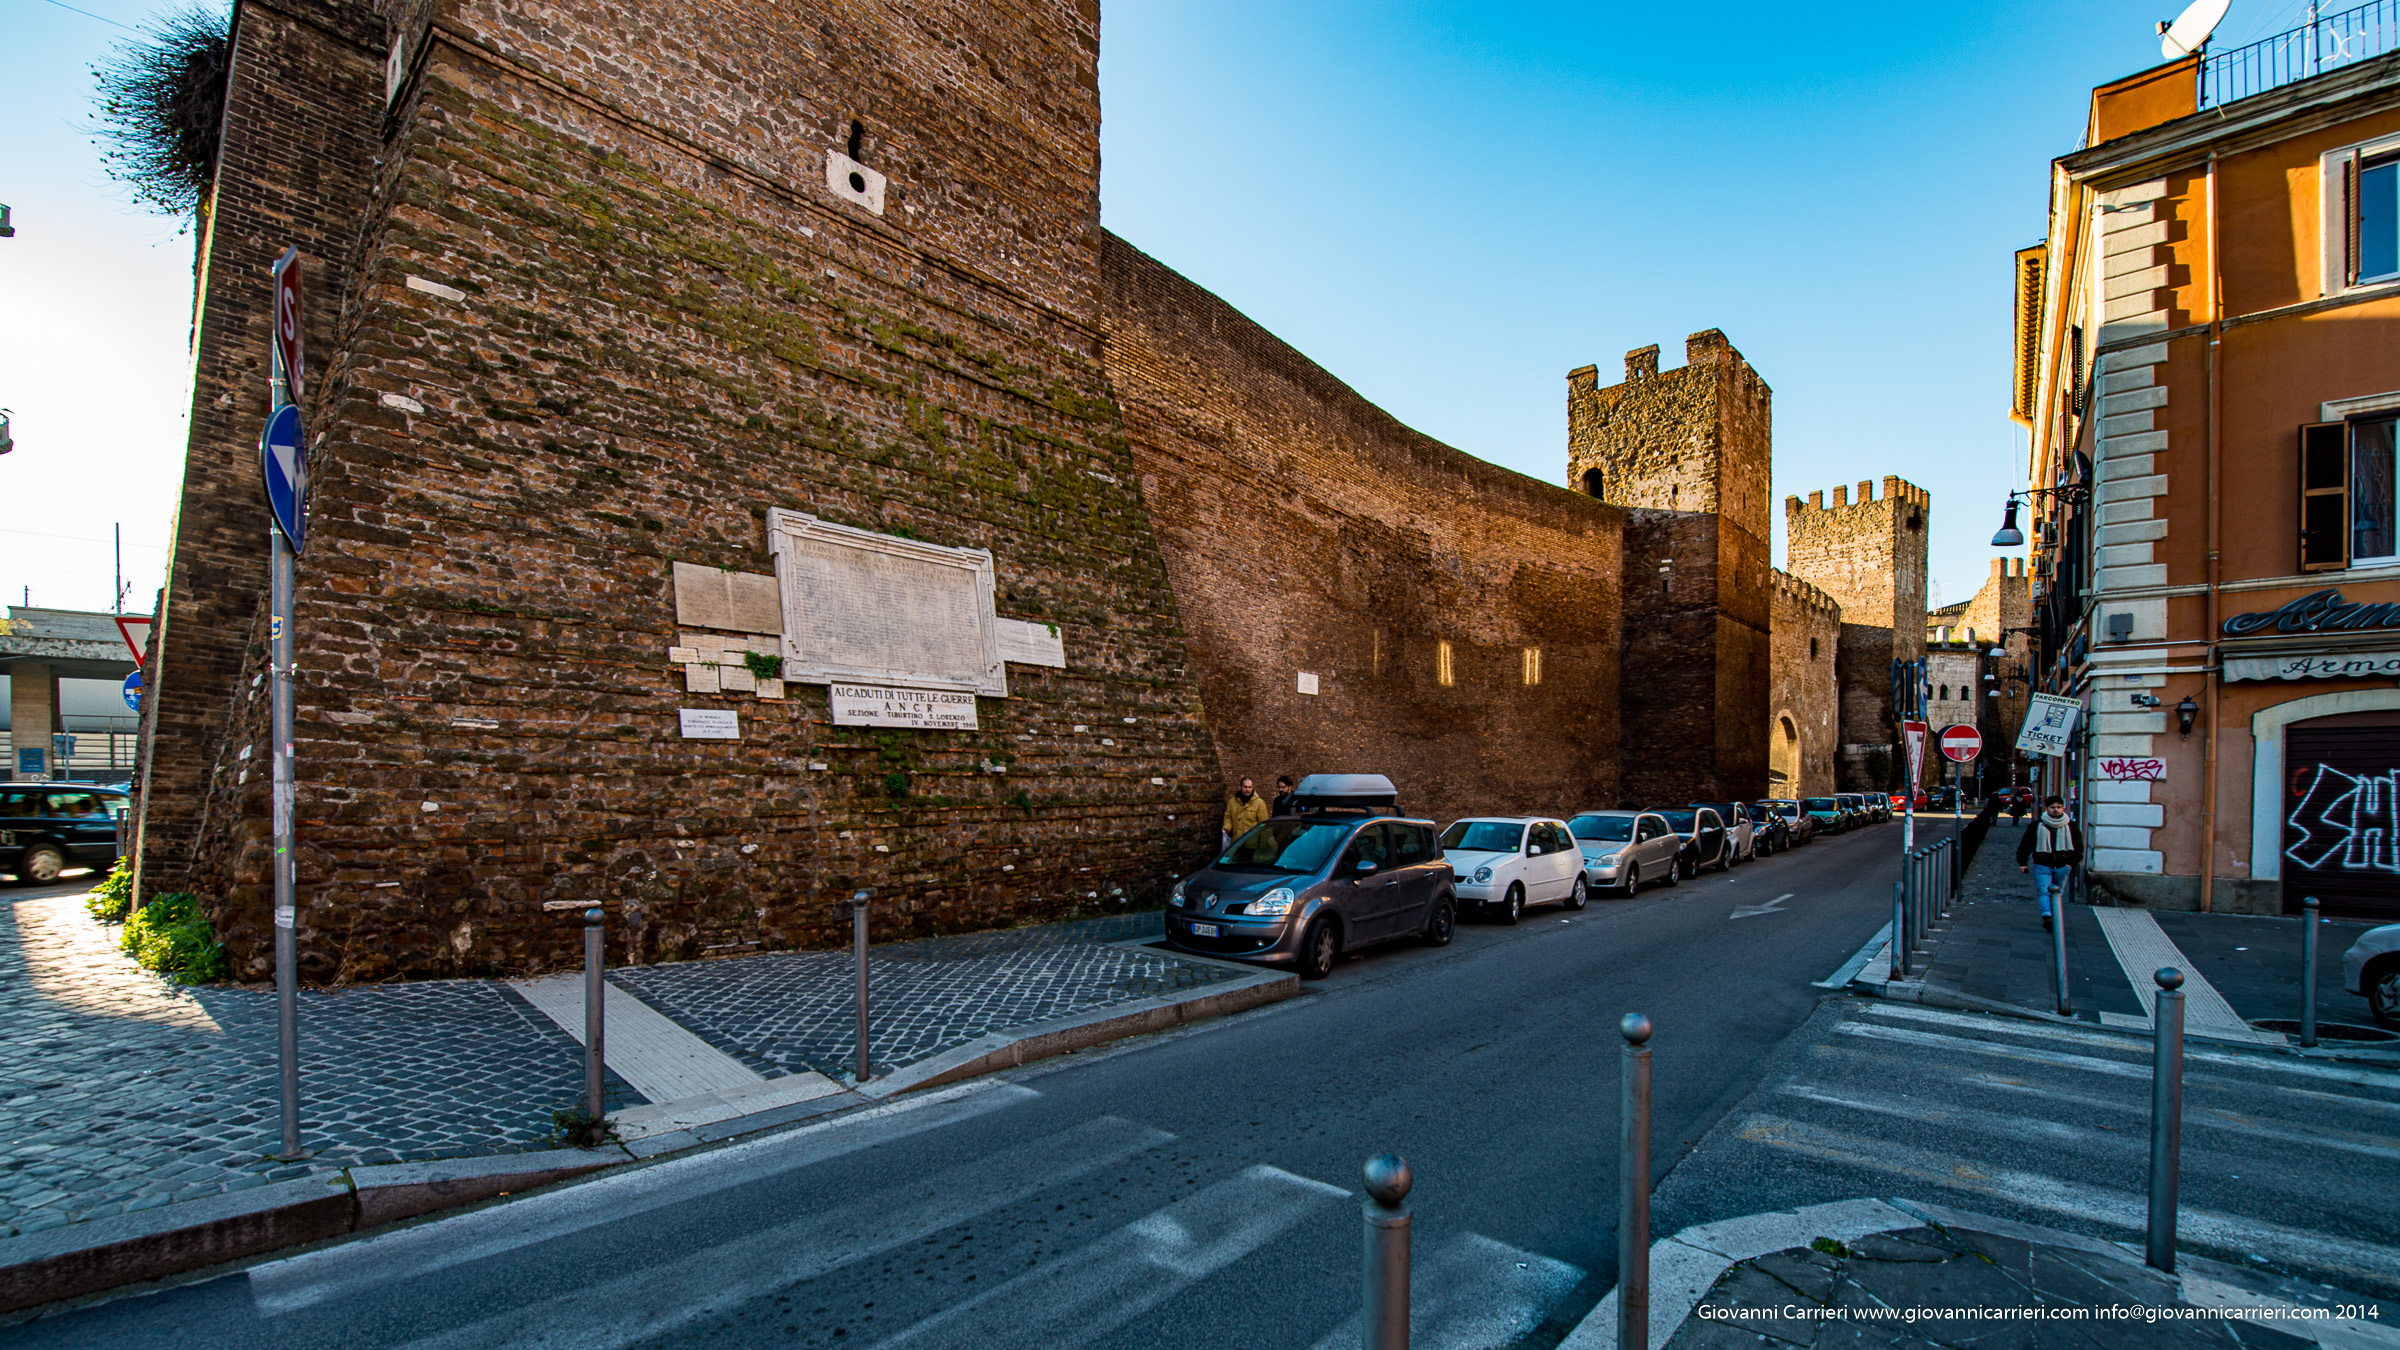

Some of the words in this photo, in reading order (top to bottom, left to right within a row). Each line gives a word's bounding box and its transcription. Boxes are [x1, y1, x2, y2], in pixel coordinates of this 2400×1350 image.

[834, 687, 845, 697] AI
[846, 688, 883, 700] CADUTI
[884, 690, 894, 700] DI
[897, 691, 926, 703] TUTTE
[927, 693, 939, 703] LE
[940, 694, 974, 705] GUERRE
[2034, 694, 2080, 706] PARCOMETRO
[847, 709, 879, 717] SEZIONE
[887, 711, 924, 720] TIBURTINO
[936, 713, 966, 721] LORENZO
[923, 720, 959, 728] NOVEMBRE
[2027, 730, 2063, 743] TICKET
